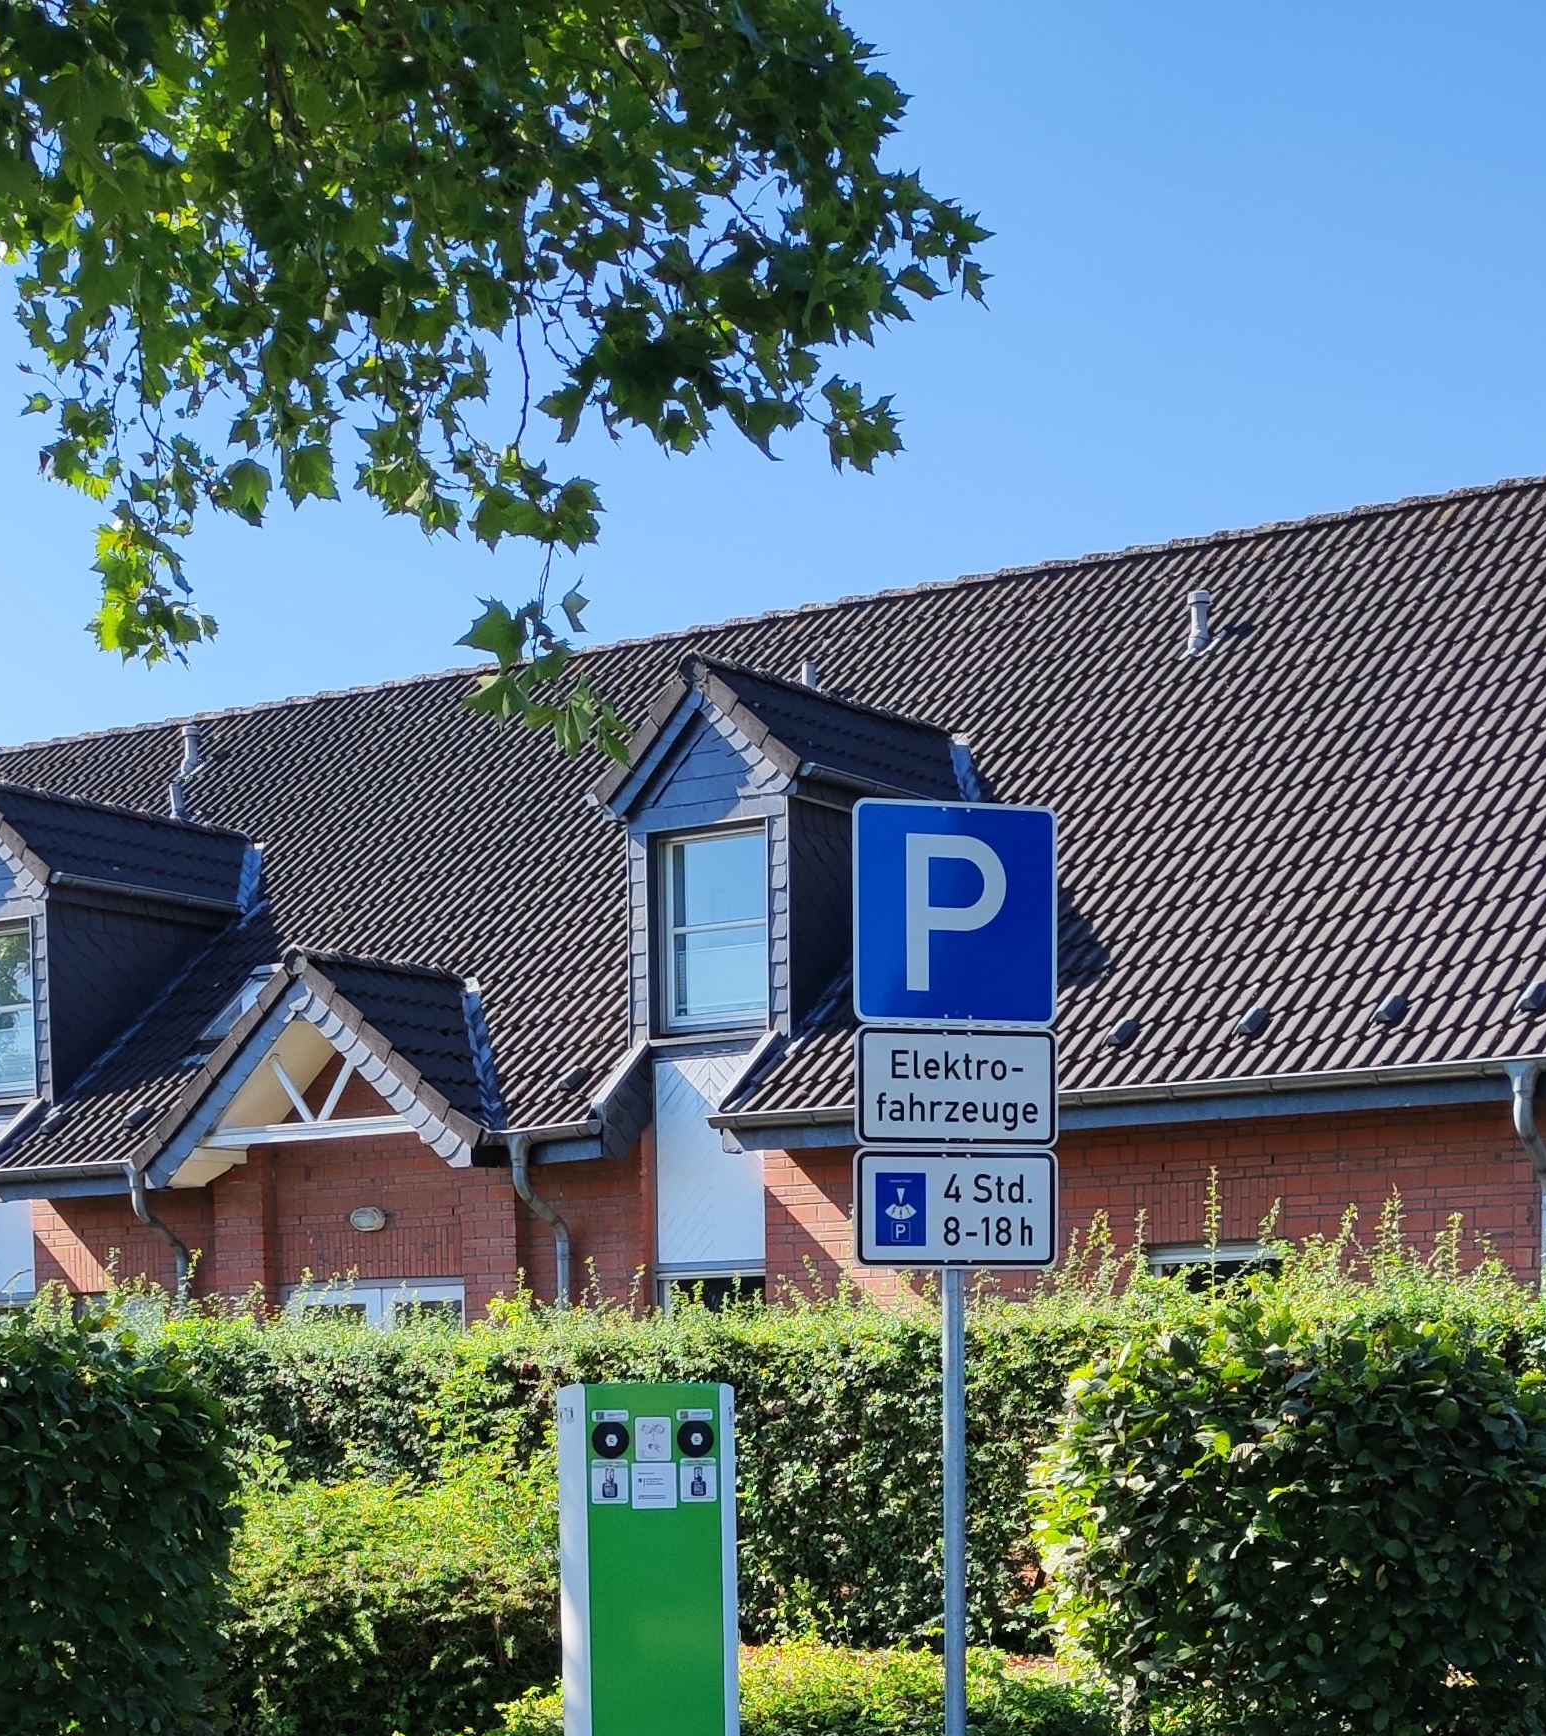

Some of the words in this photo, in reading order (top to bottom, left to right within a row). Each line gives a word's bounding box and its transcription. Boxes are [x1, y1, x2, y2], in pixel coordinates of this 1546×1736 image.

[906, 833, 1007, 991] P
[891, 1049, 1024, 1081] Elektro-
[876, 1092, 1039, 1132] fahrzeuge
[943, 1173, 962, 1203] 4
[972, 1173, 1033, 1204] Std.
[895, 1223, 907, 1240] P
